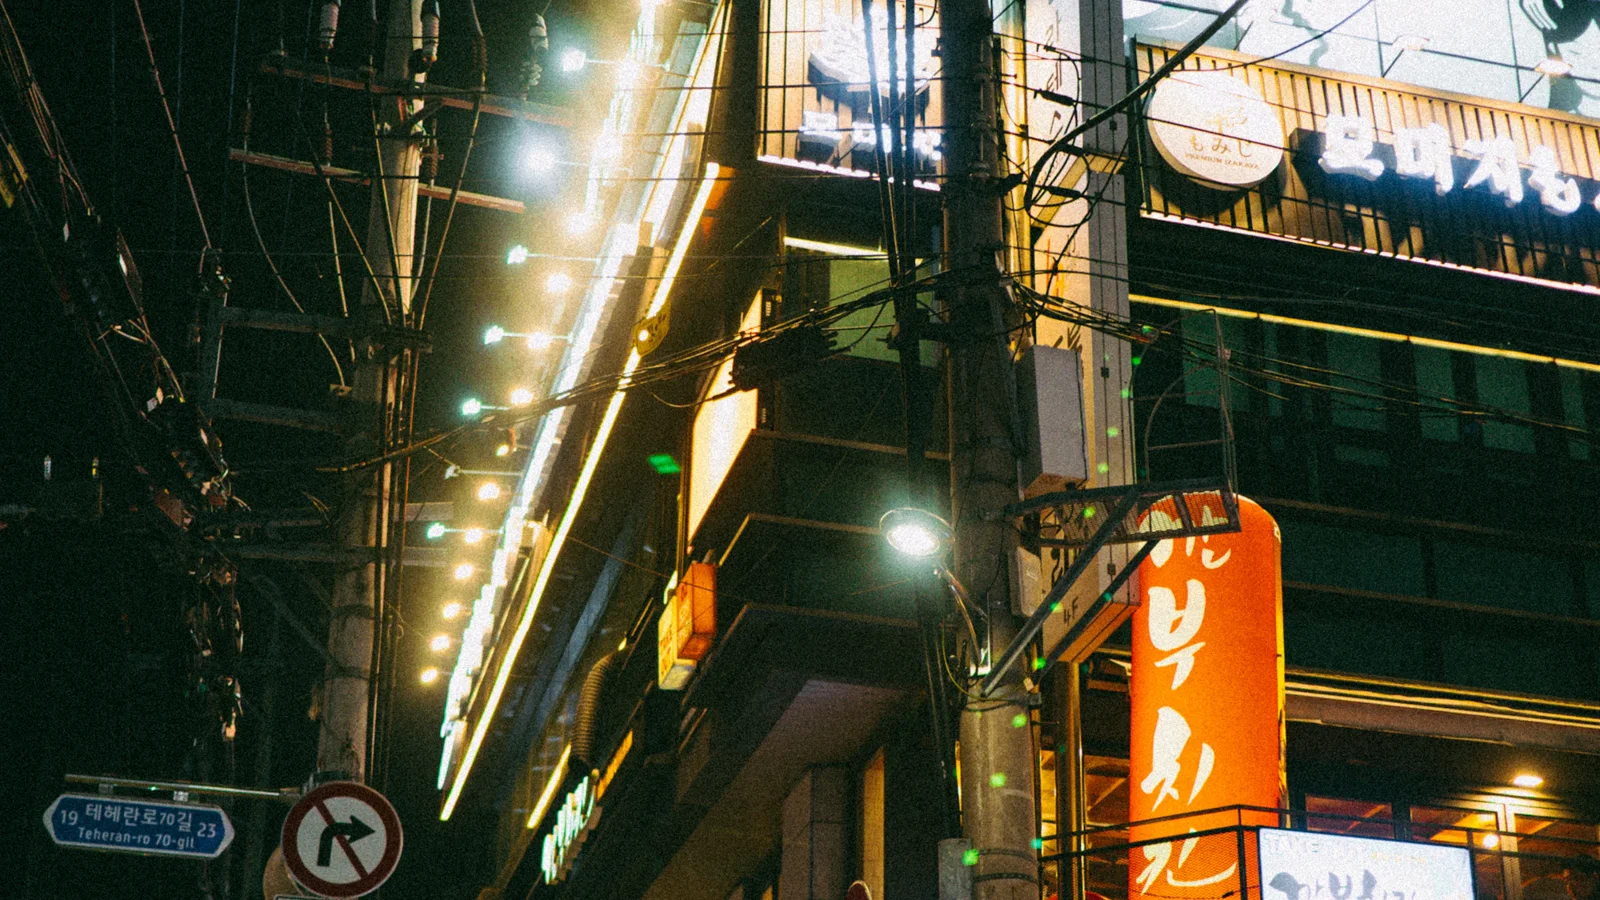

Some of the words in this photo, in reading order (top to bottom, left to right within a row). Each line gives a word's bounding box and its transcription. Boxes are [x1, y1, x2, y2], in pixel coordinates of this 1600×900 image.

[1189, 133, 1253, 158] もみじ
[1184, 152, 1222, 165] PREMIUM
[60, 809, 79, 826] 19
[85, 802, 193, 833] 테헤란로70길
[196, 822, 217, 839] 23
[78, 826, 151, 846] Teheran-ro
[155, 833, 195, 850] 70-gil
